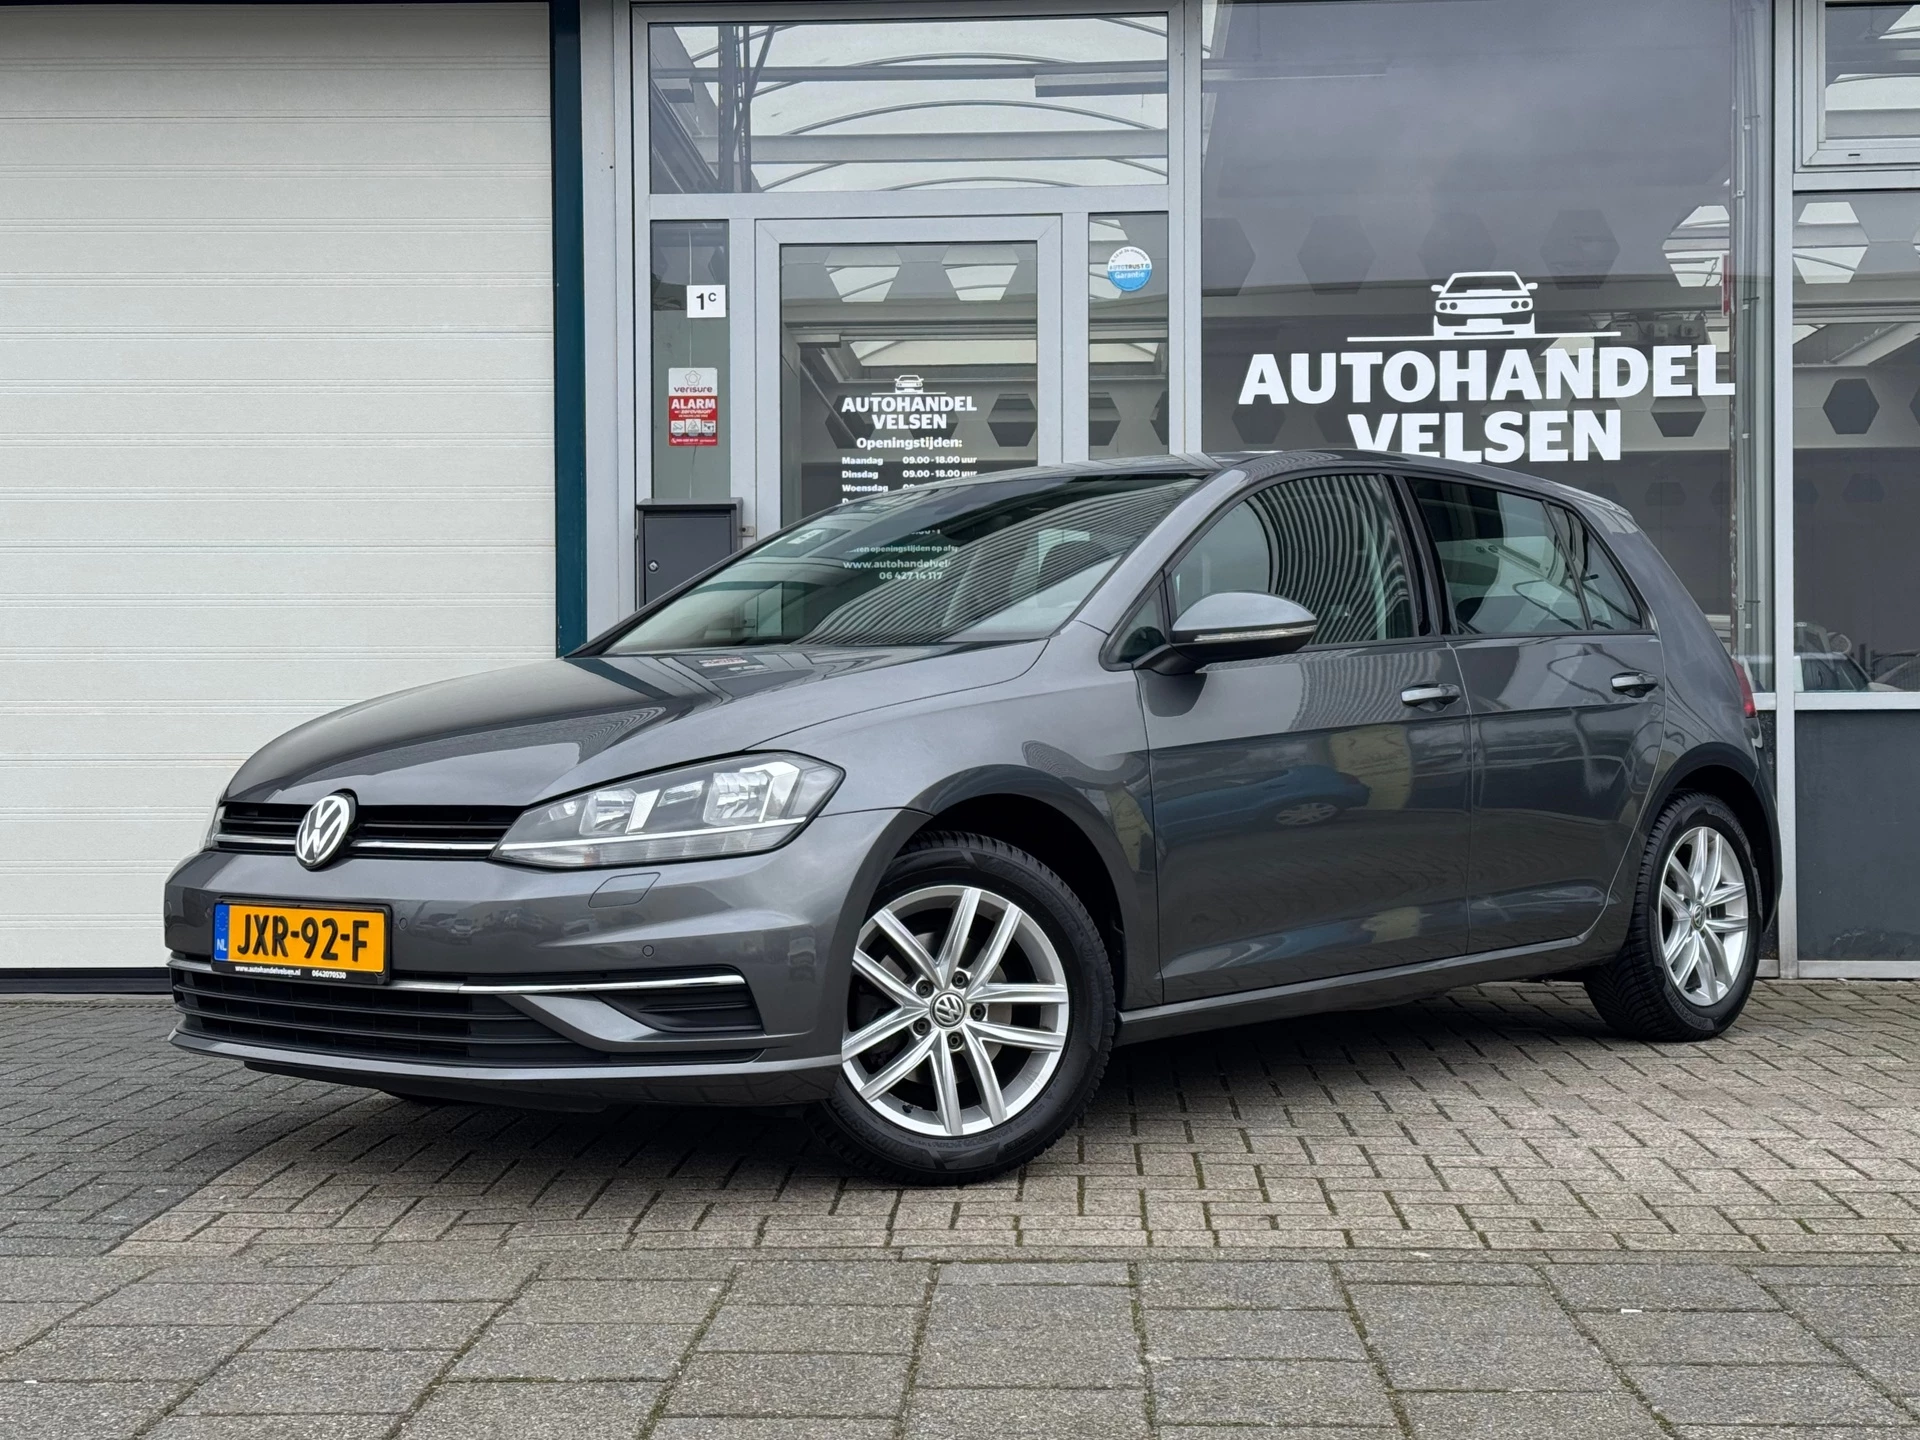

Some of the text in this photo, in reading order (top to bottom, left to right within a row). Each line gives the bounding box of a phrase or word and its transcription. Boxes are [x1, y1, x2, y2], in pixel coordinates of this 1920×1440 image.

[1114, 270, 1146, 279] Garantie
[1238, 344, 1736, 405] AUTOHANDEL
[671, 398, 716, 410] ALARM
[841, 396, 978, 412] AUTOHANDEL
[871, 413, 948, 430] VELSEN
[1347, 409, 1621, 463] VELSEN
[856, 437, 963, 450] Openingstijden:
[841, 457, 884, 466] Maandag
[902, 456, 930, 464] 09.00
[935, 455, 961, 464] 18.00
[841, 471, 879, 479] Dinsdag
[902, 470, 930, 478] 09.00
[935, 469, 961, 478] 18.00
[841, 484, 889, 493] Woensdag
[870, 545, 930, 554] openingstijden
[931, 545, 942, 553] op
[879, 571, 893, 580] 06
[237, 914, 370, 962] JXR-92-F
[216, 938, 228, 952] NL
[311, 969, 347, 980] 0642070530
